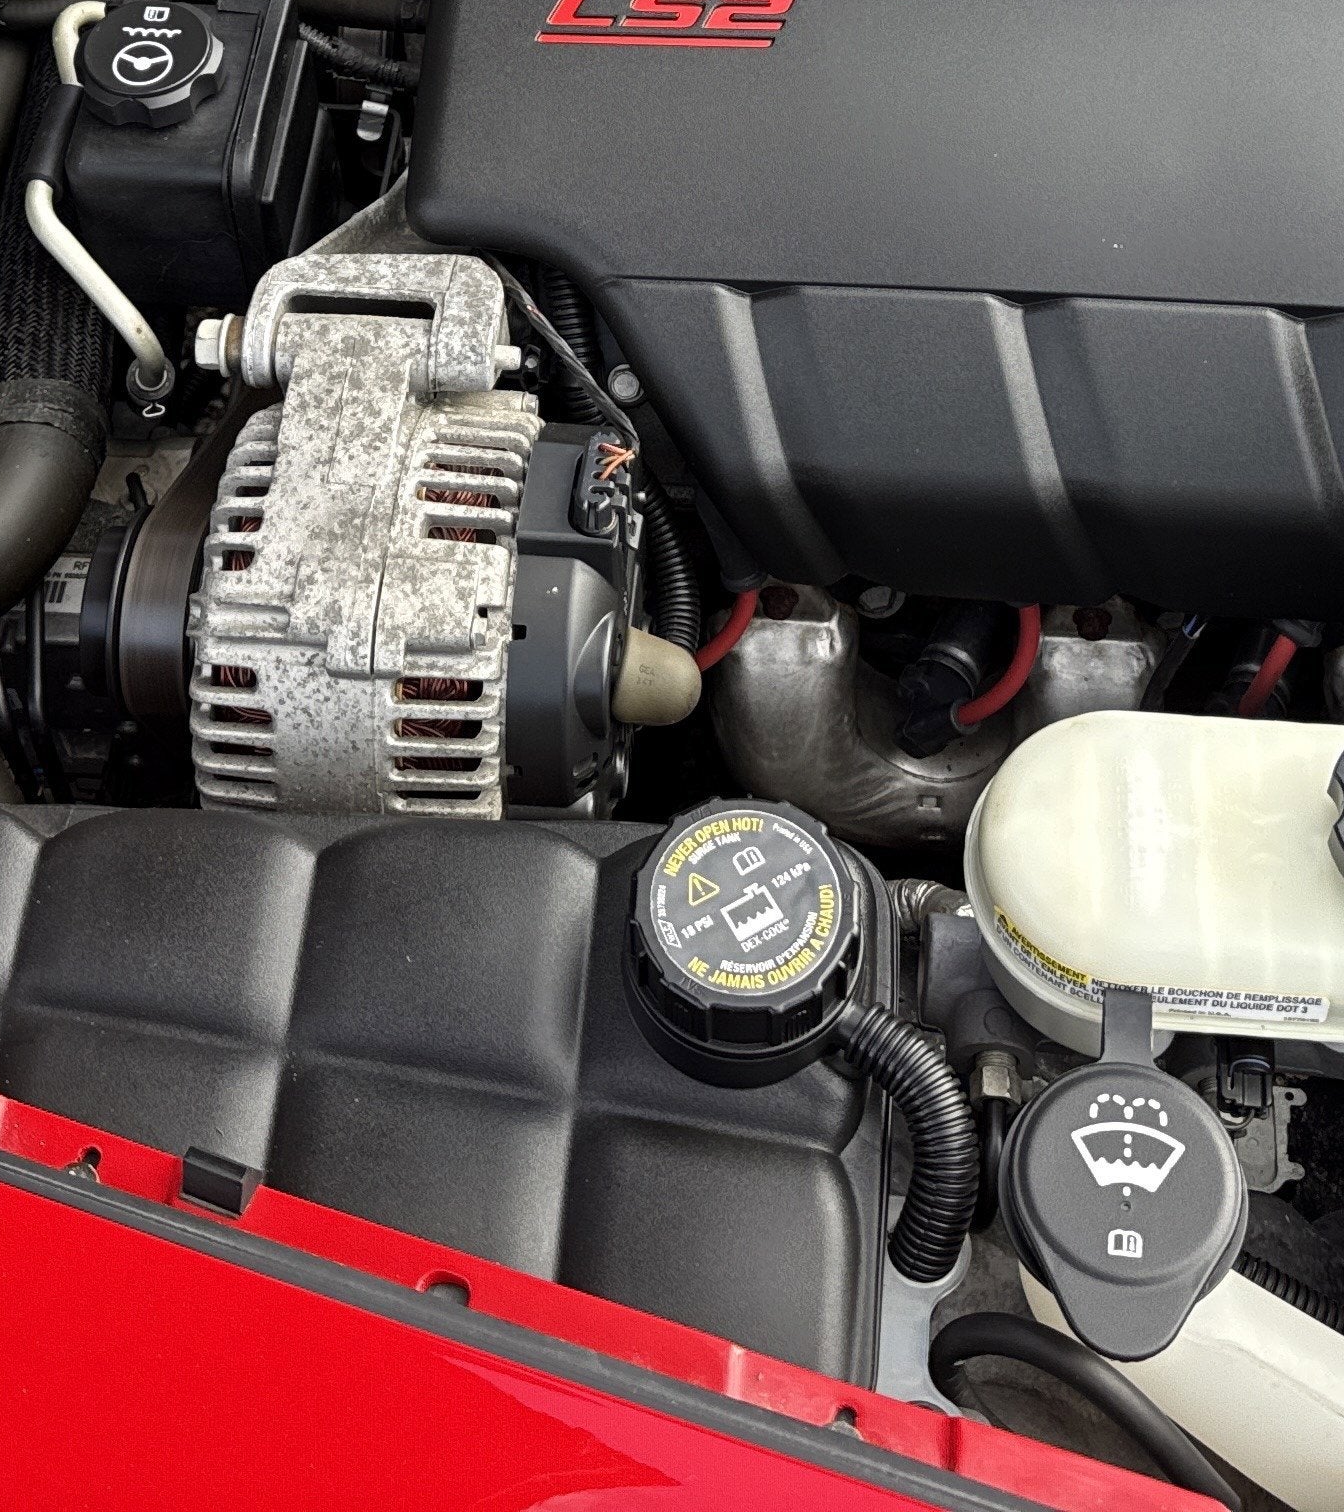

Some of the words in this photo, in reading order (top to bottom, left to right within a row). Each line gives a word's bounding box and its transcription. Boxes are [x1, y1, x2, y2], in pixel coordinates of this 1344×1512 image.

[664, 838, 696, 878] NEVER
[696, 819, 730, 842] OPEN
[732, 817, 764, 832] HOT!
[688, 840, 716, 865] SURGE
[717, 832, 742, 848] TANK
[771, 872, 792, 888] 124
[793, 861, 812, 878] kPa
[687, 956, 710, 979] NE
[708, 968, 766, 990] JAMAIS
[767, 949, 817, 987] OUVRIR
[815, 883, 835, 938] CHAUD!
[696, 914, 715, 933] PSI
[719, 958, 776, 974] RÉSERVOIR
[776, 911, 818, 967] D'EXPANSION
[1011, 926, 1087, 981] AVERTISSEMENT
[1151, 985, 1166, 996] LE
[1167, 986, 1224, 1001] BOUCHON
[1226, 991, 1242, 1002] DE
[1244, 992, 1324, 1008] REMPLISSAGE
[1013, 947, 1068, 991] CONTENANT
[1152, 993, 1210, 1009] EULEMENT
[1212, 999, 1227, 1010] DU
[1229, 1000, 1275, 1014] LIQUIDE
[1276, 1003, 1299, 1014] DOT
[1300, 1005, 1308, 1014] 3
